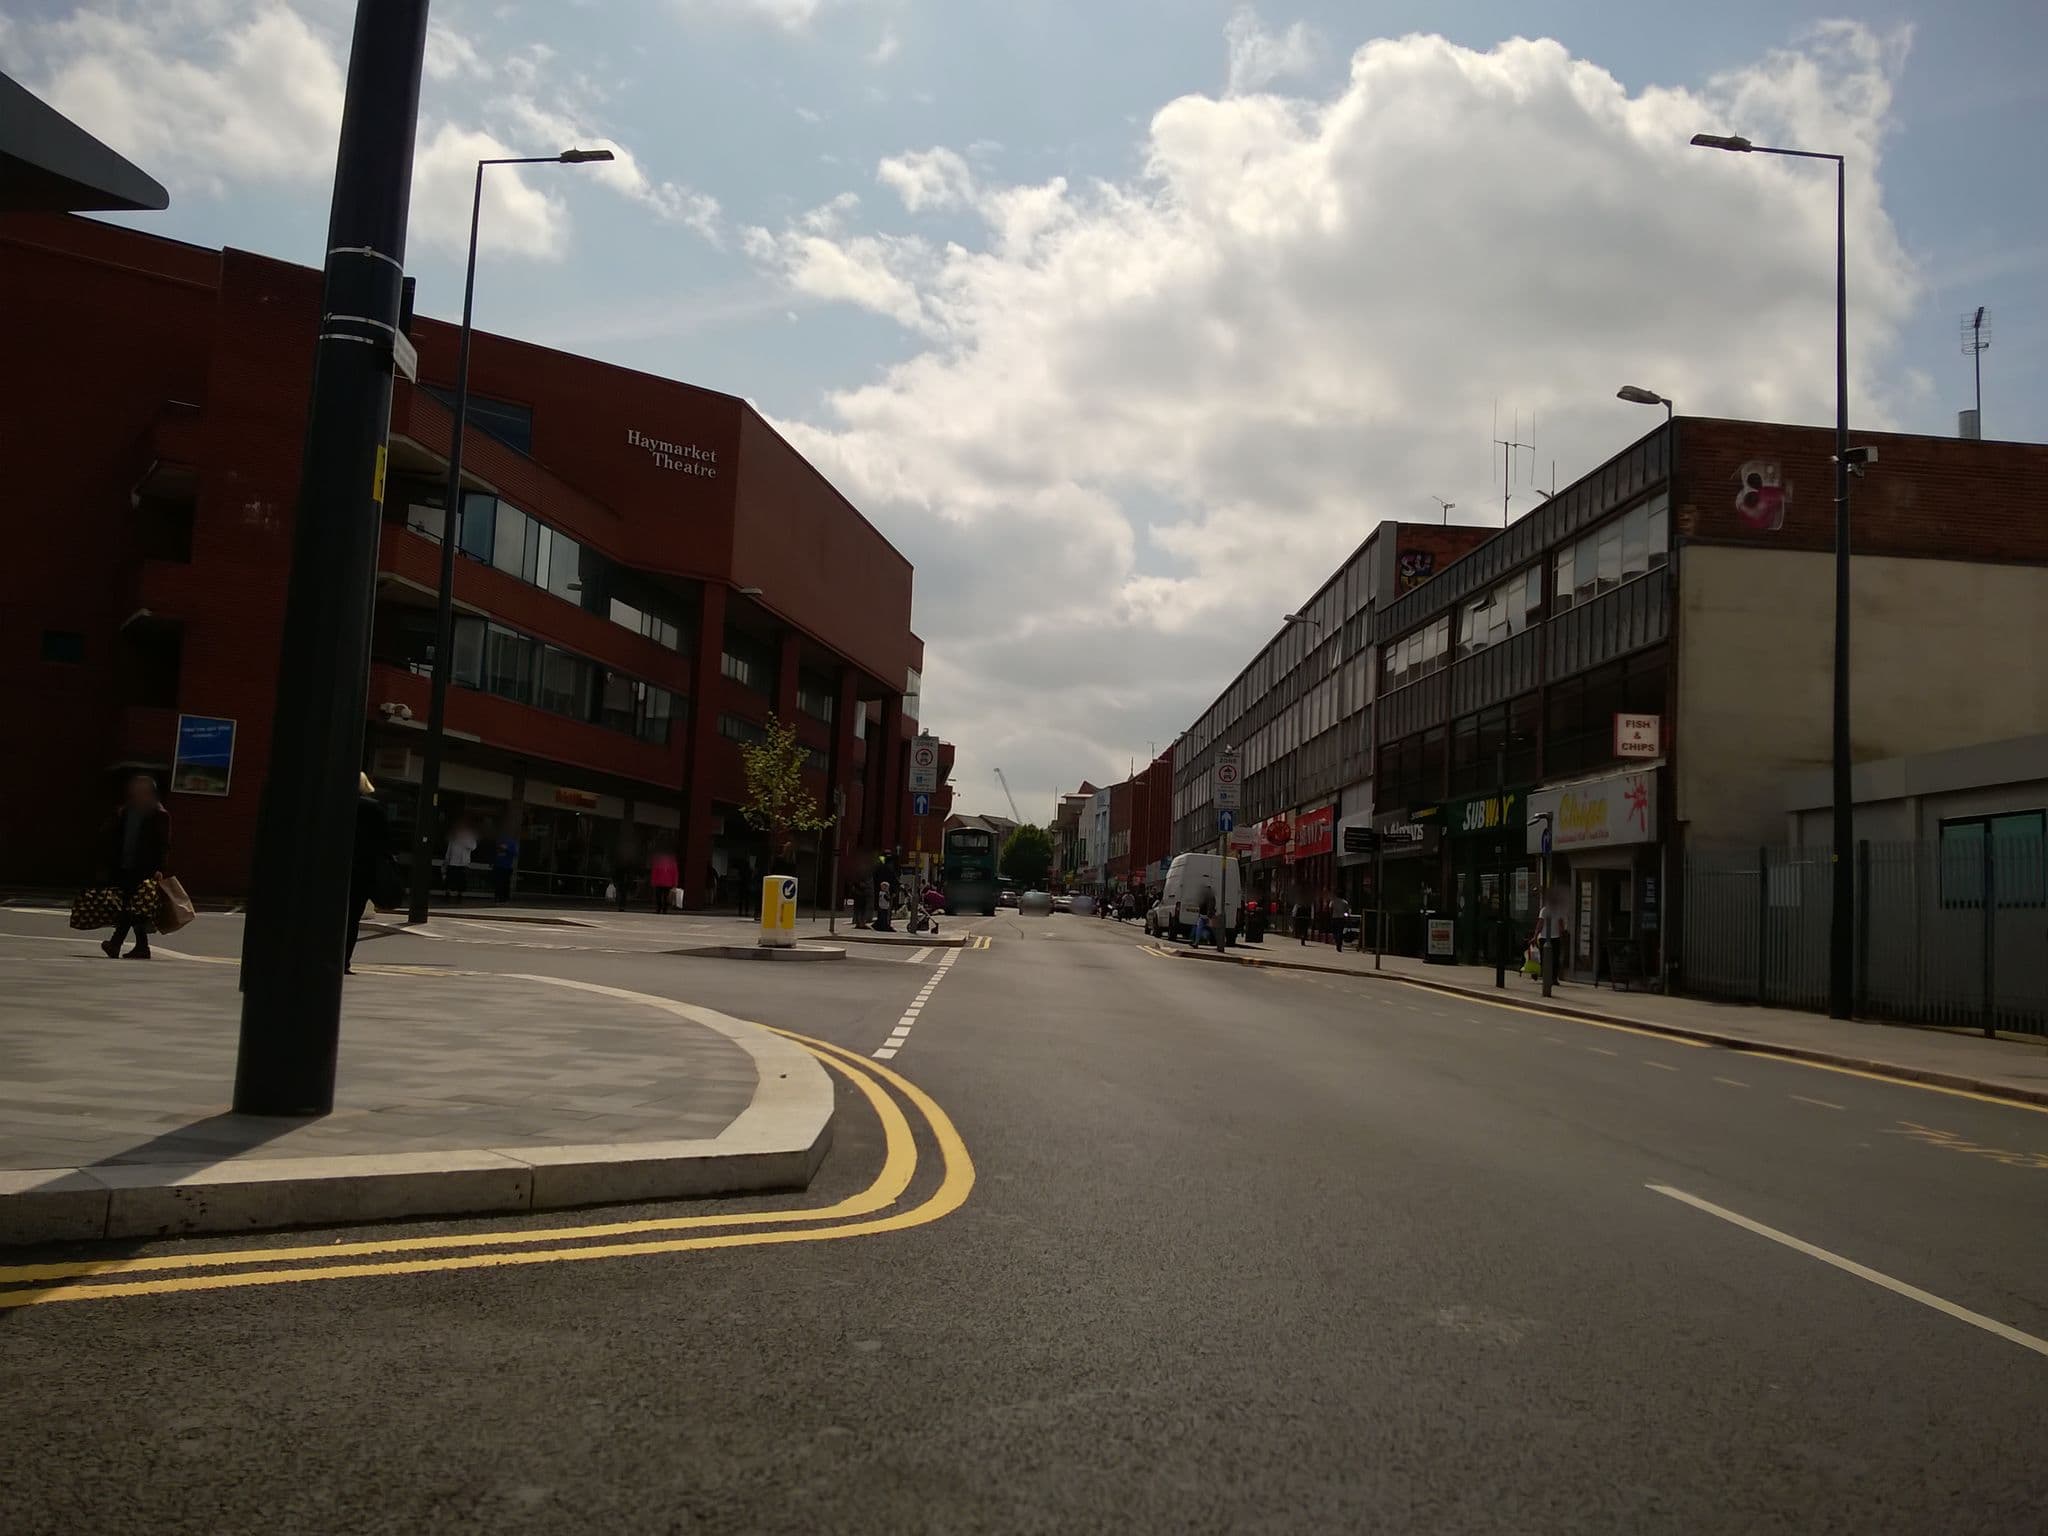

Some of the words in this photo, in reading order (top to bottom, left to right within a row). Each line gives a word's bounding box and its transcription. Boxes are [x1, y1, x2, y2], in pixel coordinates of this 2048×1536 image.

[627, 430, 717, 462] Haymarket
[652, 451, 717, 478] Theatre
[1625, 719, 1651, 729] FISH
[1633, 731, 1642, 740] &
[1621, 742, 1655, 752] CHIPS
[1463, 793, 1515, 830] SUBWAY
